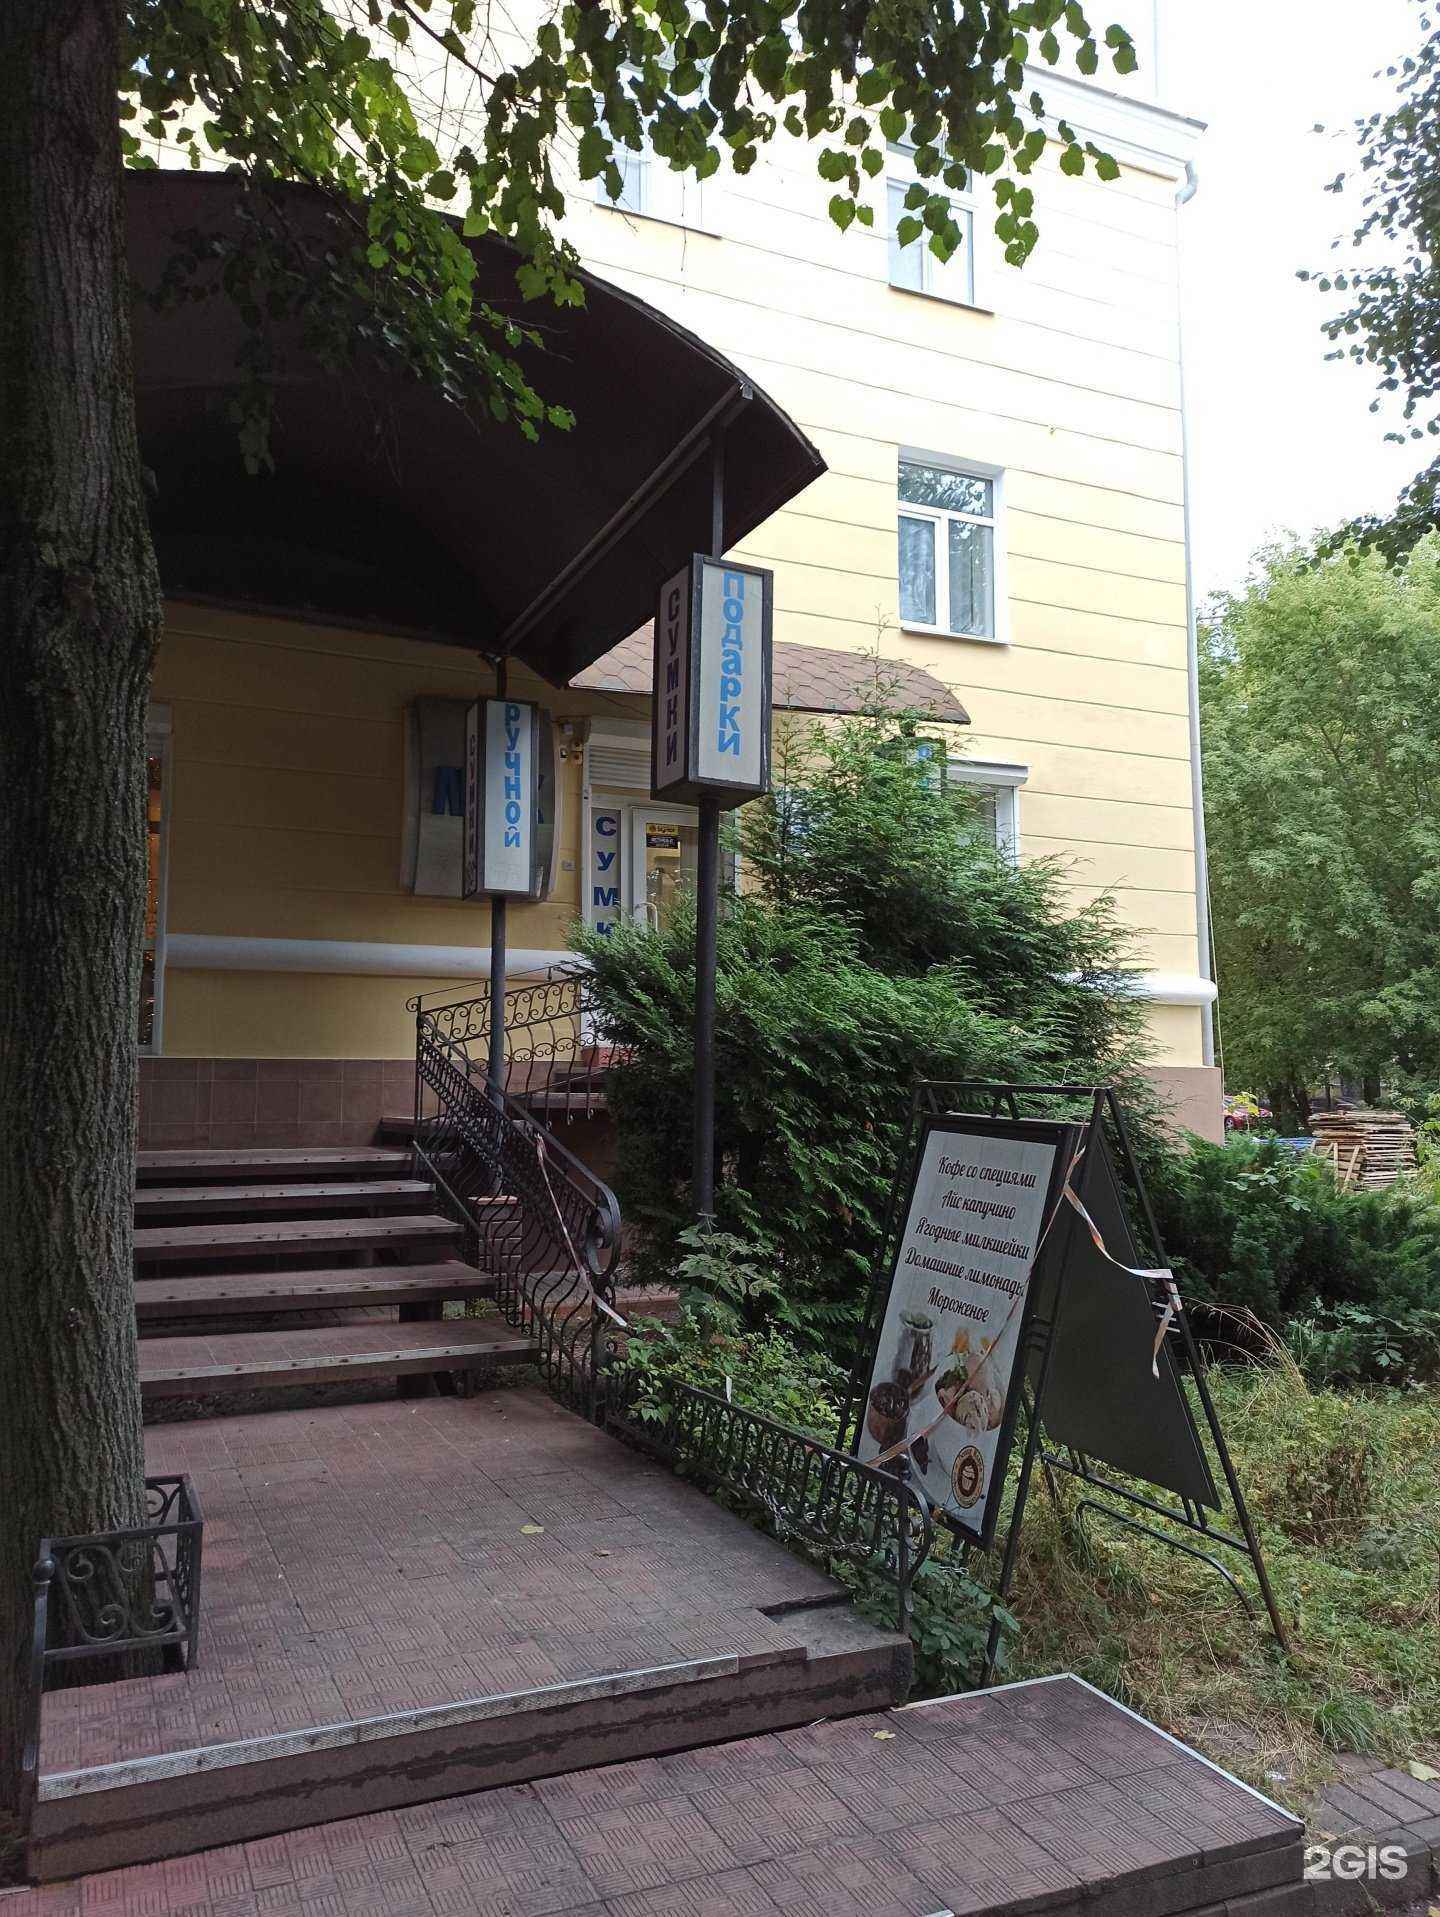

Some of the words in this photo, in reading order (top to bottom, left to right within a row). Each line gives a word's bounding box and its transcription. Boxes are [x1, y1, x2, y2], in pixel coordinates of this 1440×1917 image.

[939, 1156, 965, 1180] Кофе
[966, 1166, 979, 1179] со
[979, 1166, 1037, 1189] специями
[941, 1189, 962, 1209] Айс
[962, 1198, 1016, 1220] капучино
[915, 1216, 962, 1243] Ягодные
[961, 1232, 1030, 1260] милкшейки
[905, 1246, 965, 1279] Домашние
[927, 1286, 990, 1322] Мороженое
